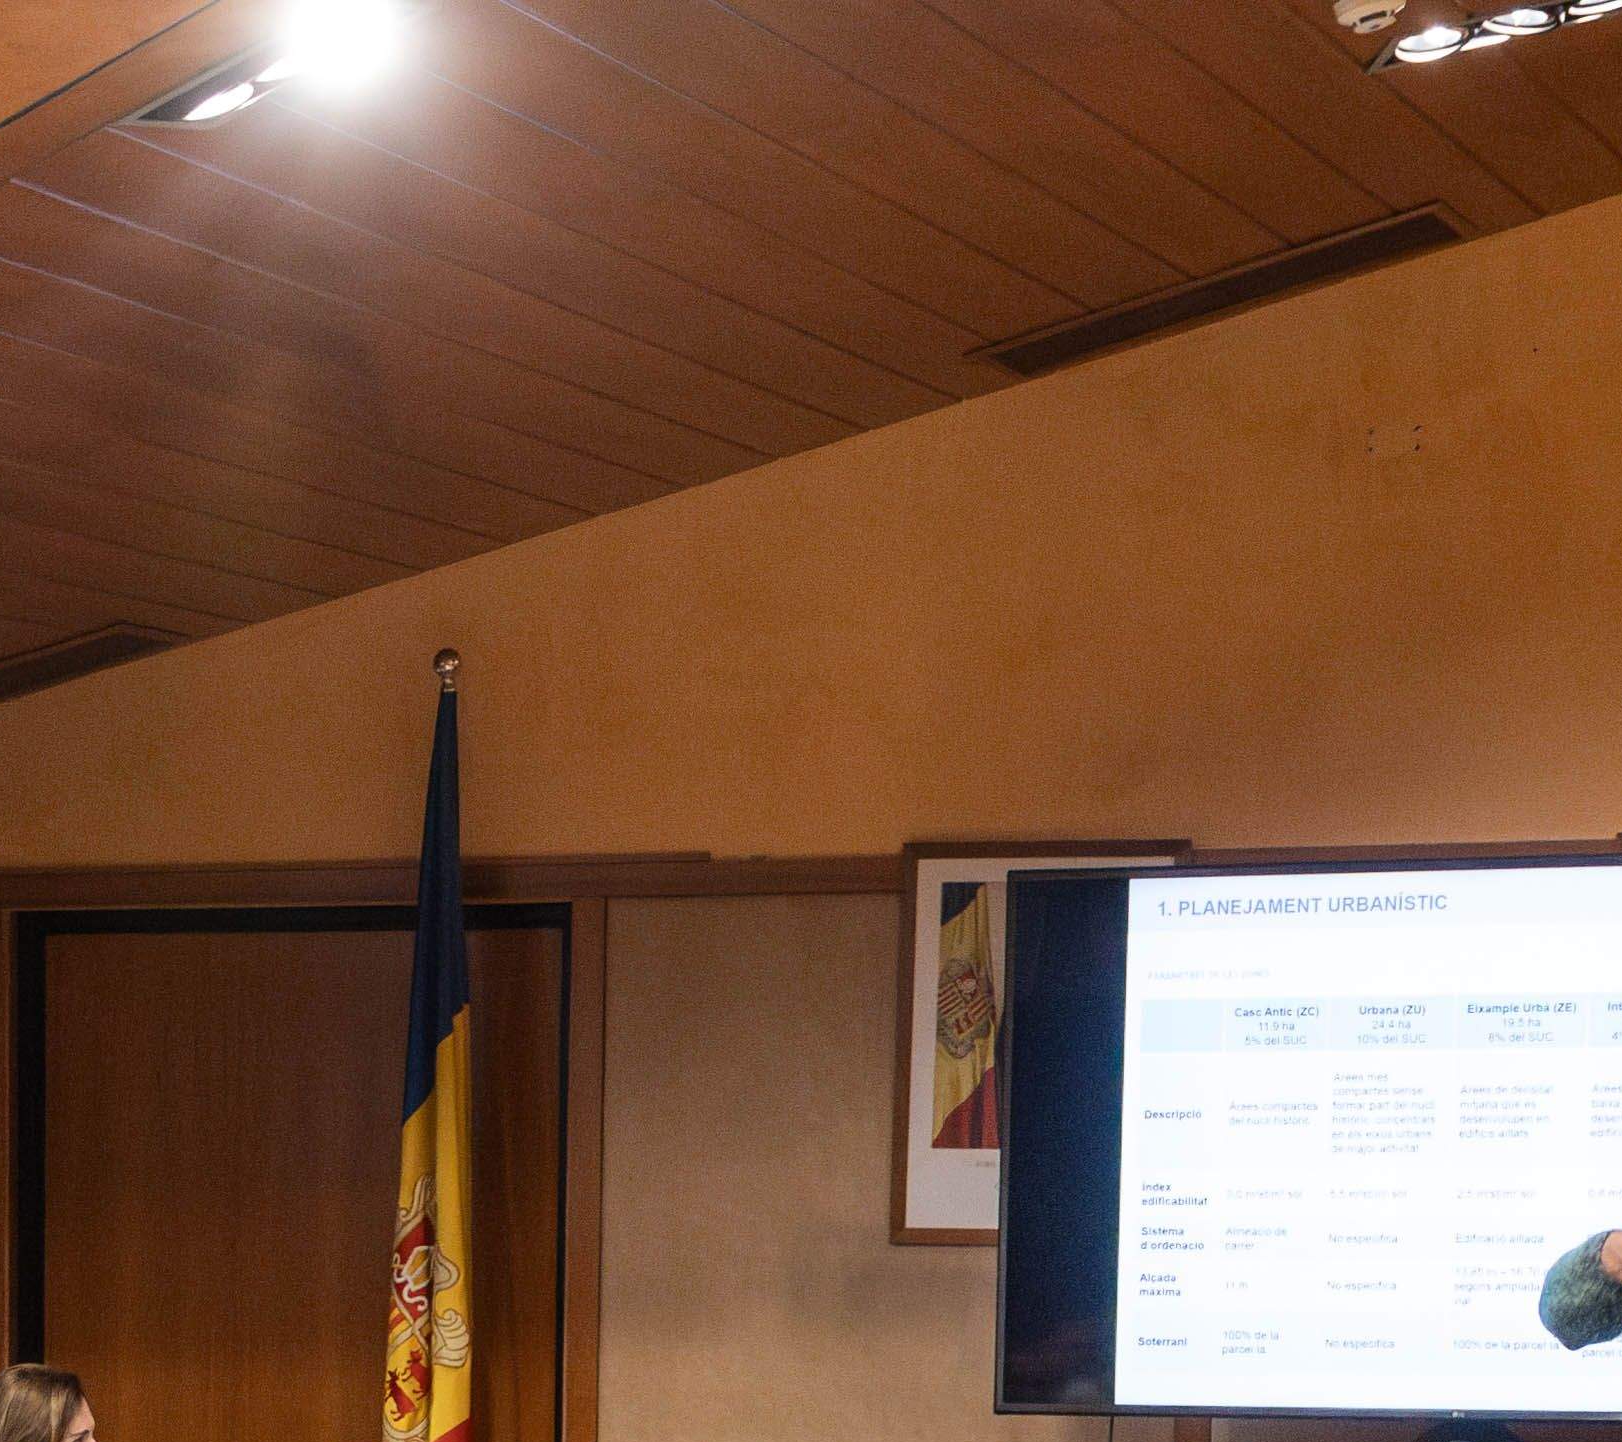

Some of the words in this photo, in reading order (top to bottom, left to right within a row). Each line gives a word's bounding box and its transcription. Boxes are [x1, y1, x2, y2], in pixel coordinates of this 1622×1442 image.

[1157, 900, 1172, 917] 1.
[1178, 896, 1323, 917] PLANEJAMENT
[1327, 892, 1448, 914] URBANÍSTIC
[1234, 1007, 1262, 1018] Casc
[1264, 1006, 1293, 1017] Antic
[1297, 1005, 1320, 1018] (ZC)
[1358, 1005, 1399, 1016] Urbana
[1402, 1004, 1426, 1017] (ZU)
[1467, 1003, 1521, 1016] Eixample
[1553, 1002, 1577, 1014] (ZE)
[1140, 1226, 1185, 1237] Sistema
[1137, 1335, 1189, 1348] Soterrani
